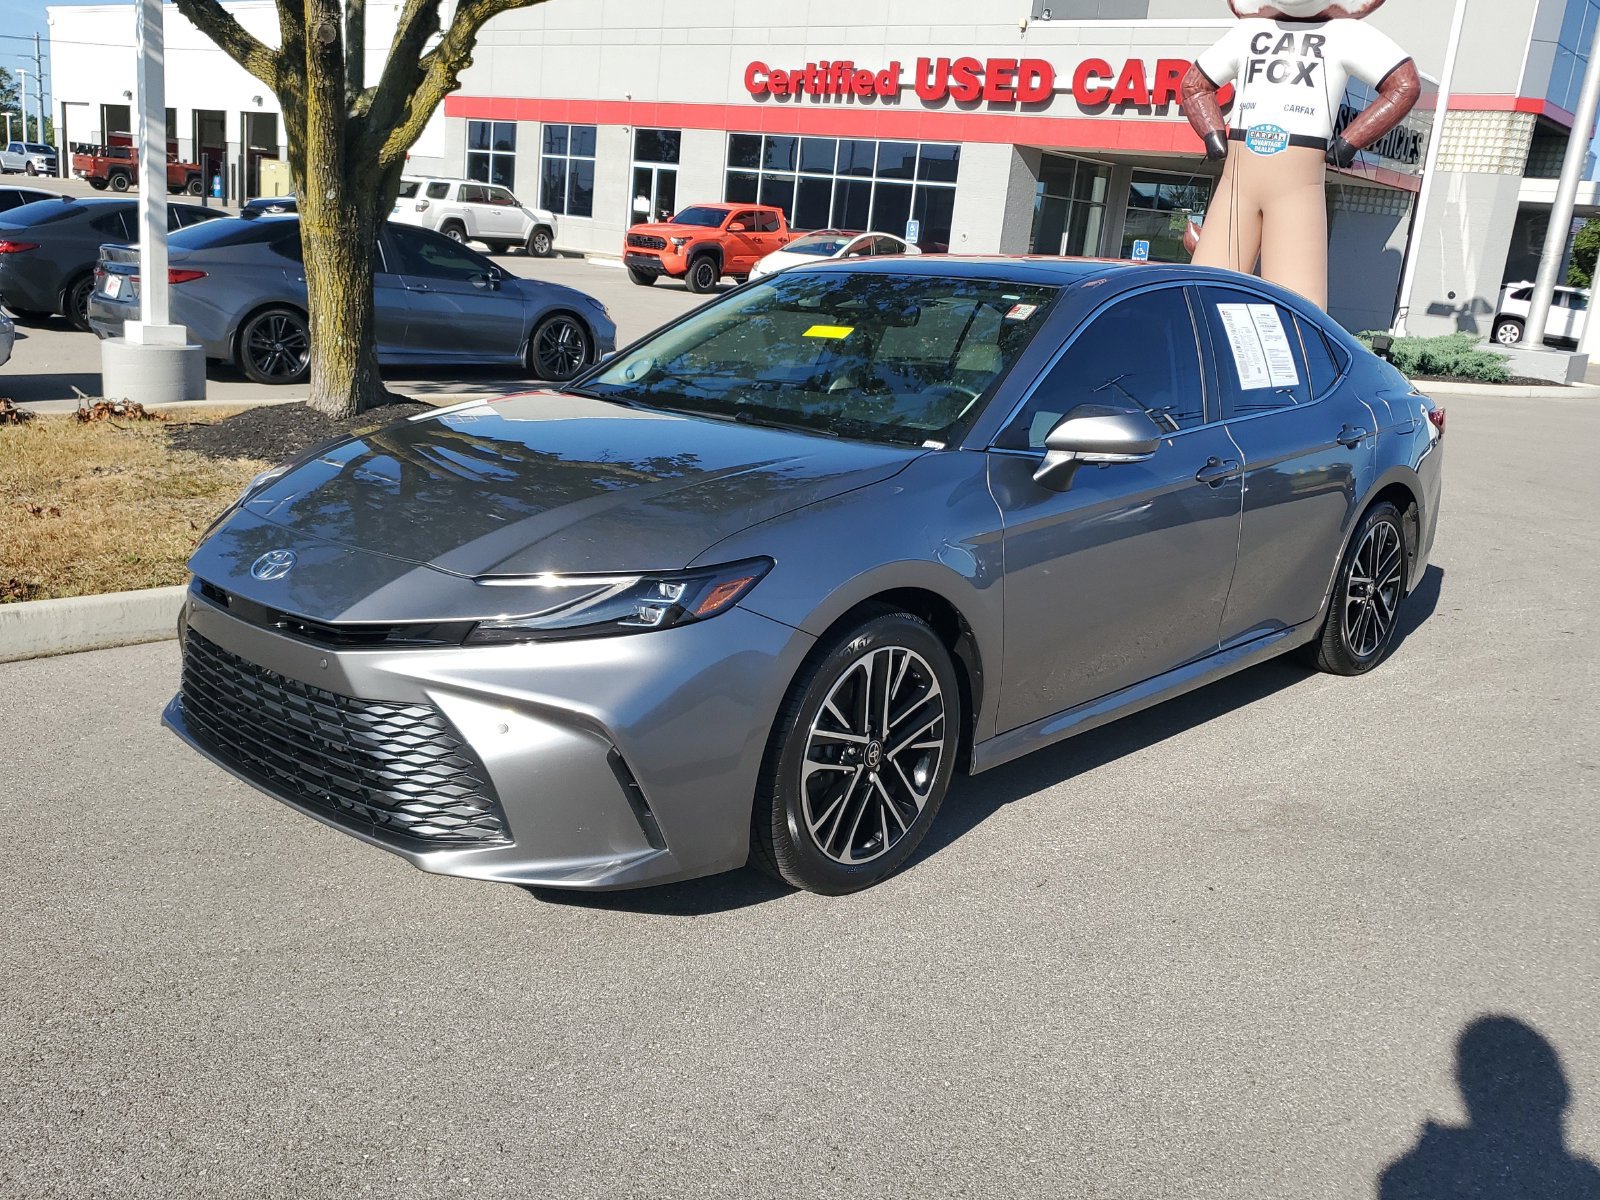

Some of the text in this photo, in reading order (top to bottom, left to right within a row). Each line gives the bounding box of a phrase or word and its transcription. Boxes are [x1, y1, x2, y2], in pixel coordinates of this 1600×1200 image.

[1250, 32, 1326, 58] CAR
[744, 61, 900, 96] Certified
[915, 57, 1055, 102] USED
[1247, 59, 1318, 88] FOX
[1284, 104, 1315, 116] CARFAX
[1250, 139, 1283, 147] ADVANTAGE
[1254, 145, 1275, 153] DEALER
